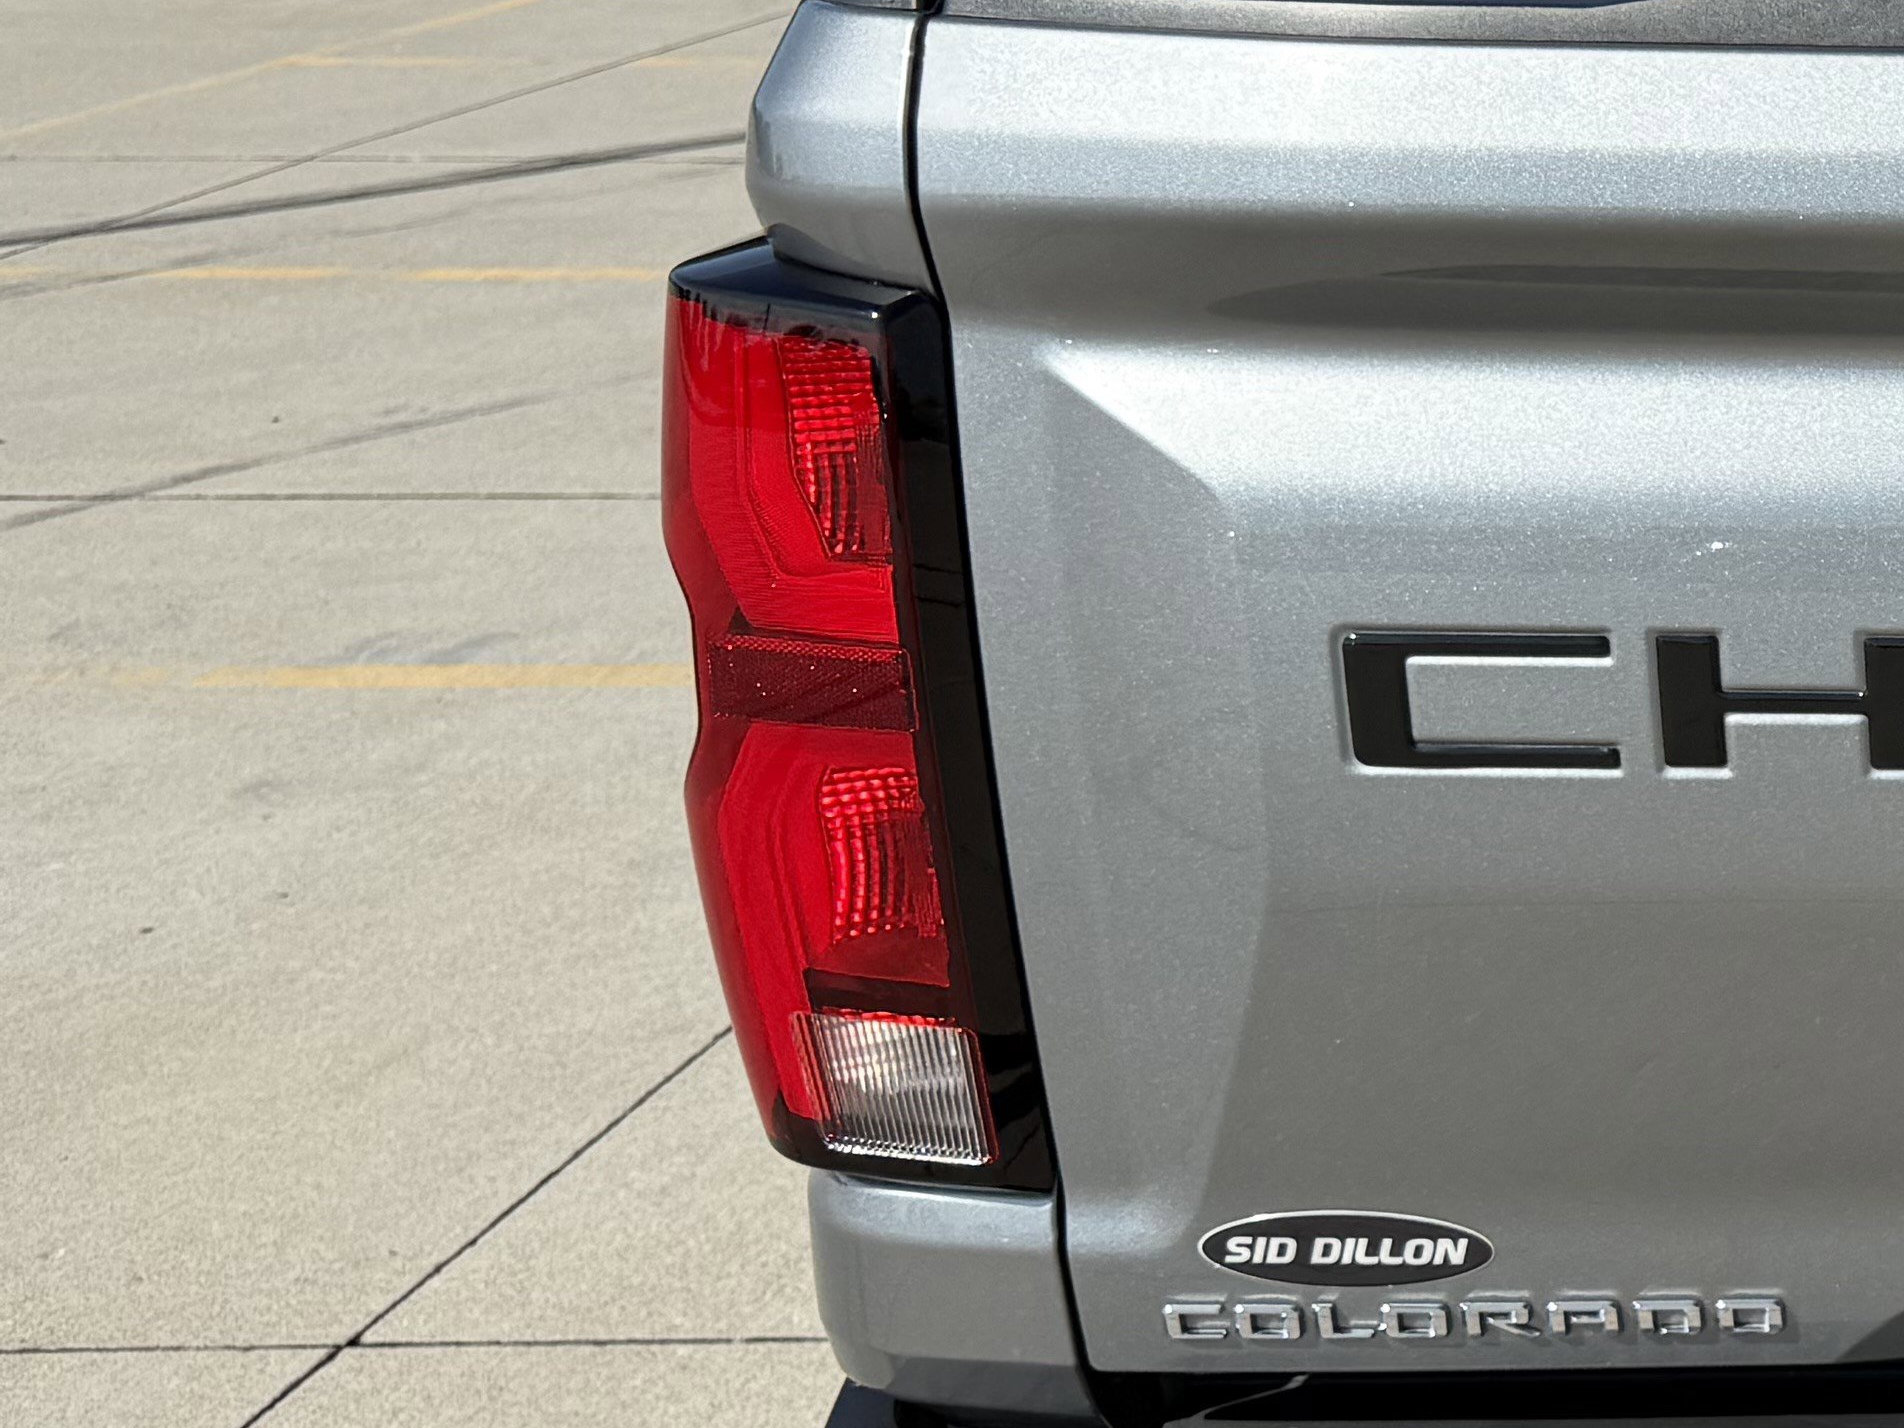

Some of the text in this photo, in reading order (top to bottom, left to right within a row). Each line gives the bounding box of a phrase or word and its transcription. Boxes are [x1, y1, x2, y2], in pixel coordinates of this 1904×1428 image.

[1224, 1235, 1469, 1267] SID DILLON
[1162, 1294, 1788, 1342] COLORADO
